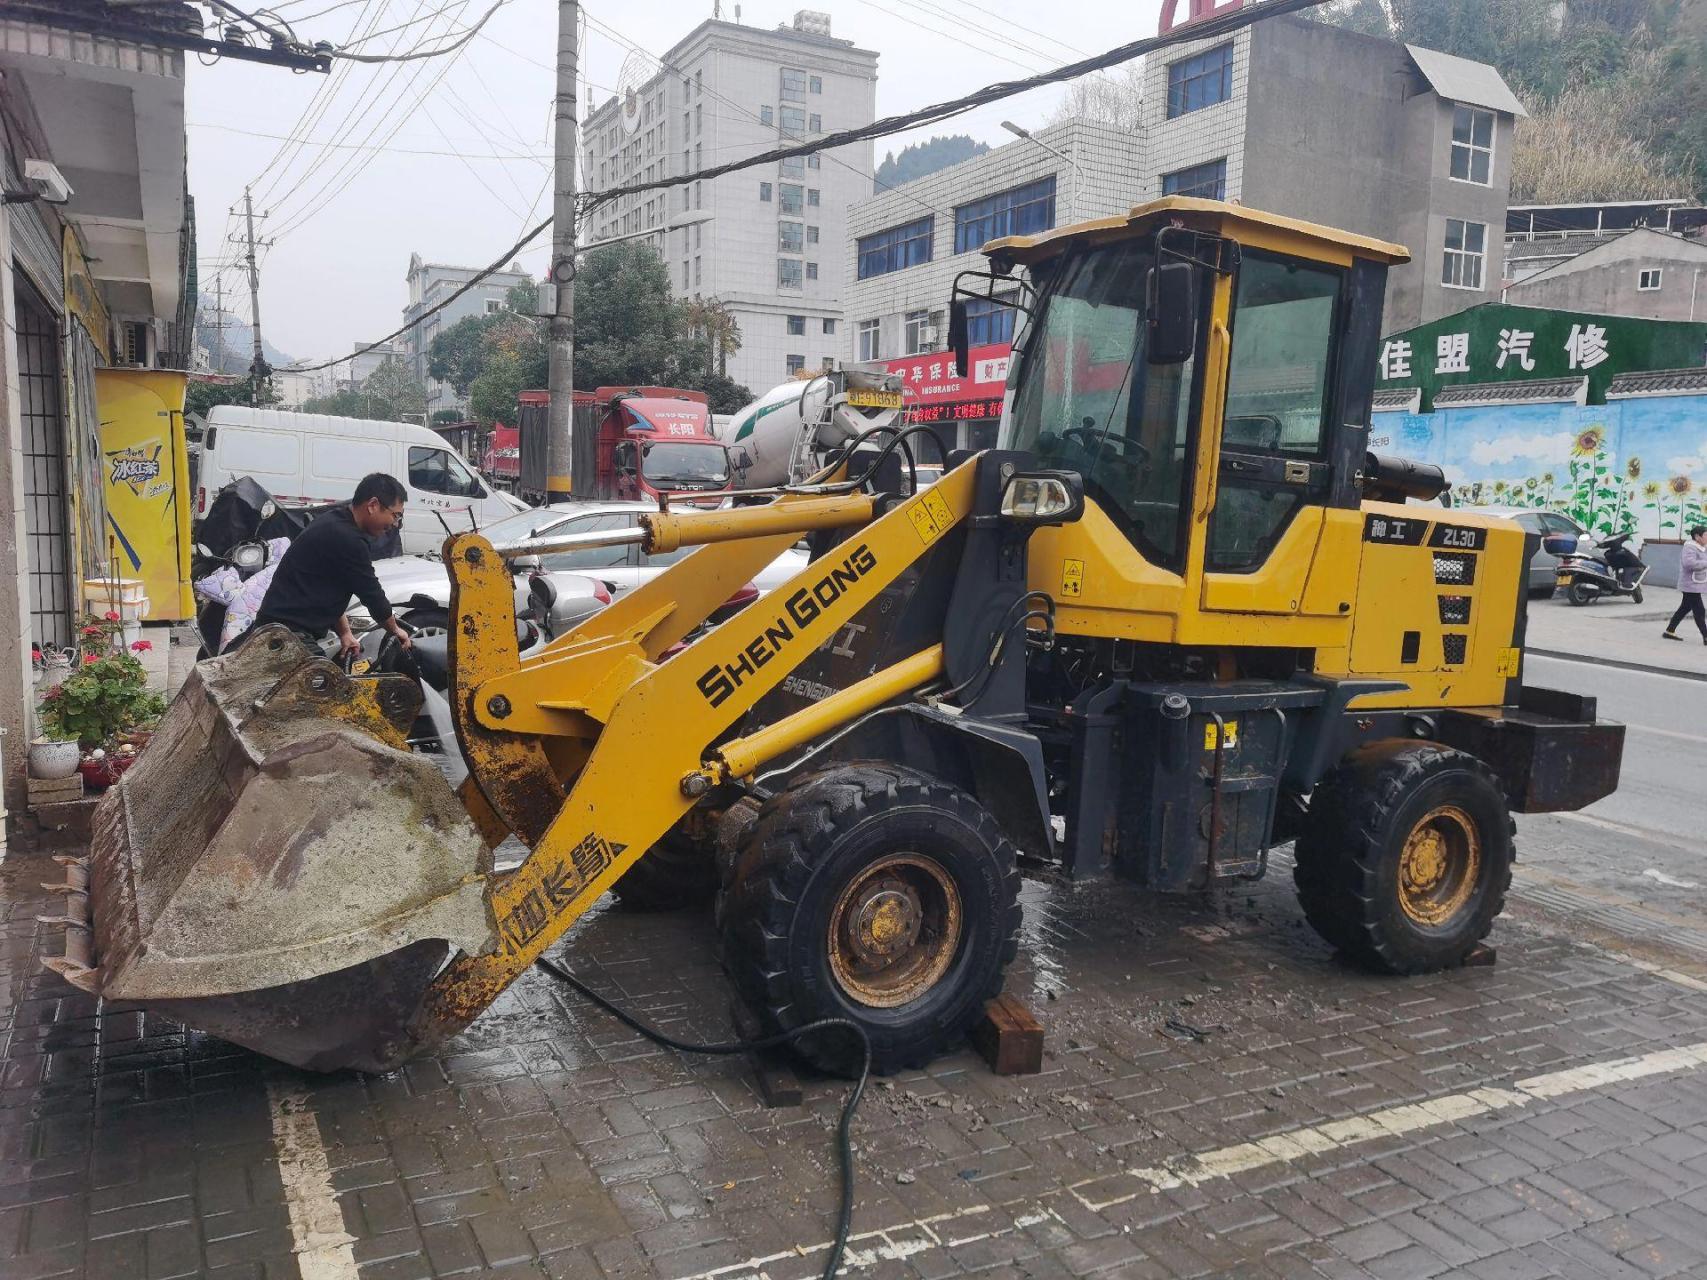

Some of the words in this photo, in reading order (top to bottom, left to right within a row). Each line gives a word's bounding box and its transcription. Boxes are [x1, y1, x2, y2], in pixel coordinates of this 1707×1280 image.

[1379, 324, 1609, 380] 佳盟汽修
[921, 383, 961, 395] INSURANCE
[668, 423, 695, 436] 长阳
[110, 458, 159, 484] 冰红茶
[1443, 528, 1476, 548] ZL30
[781, 675, 842, 702] SHENGON
